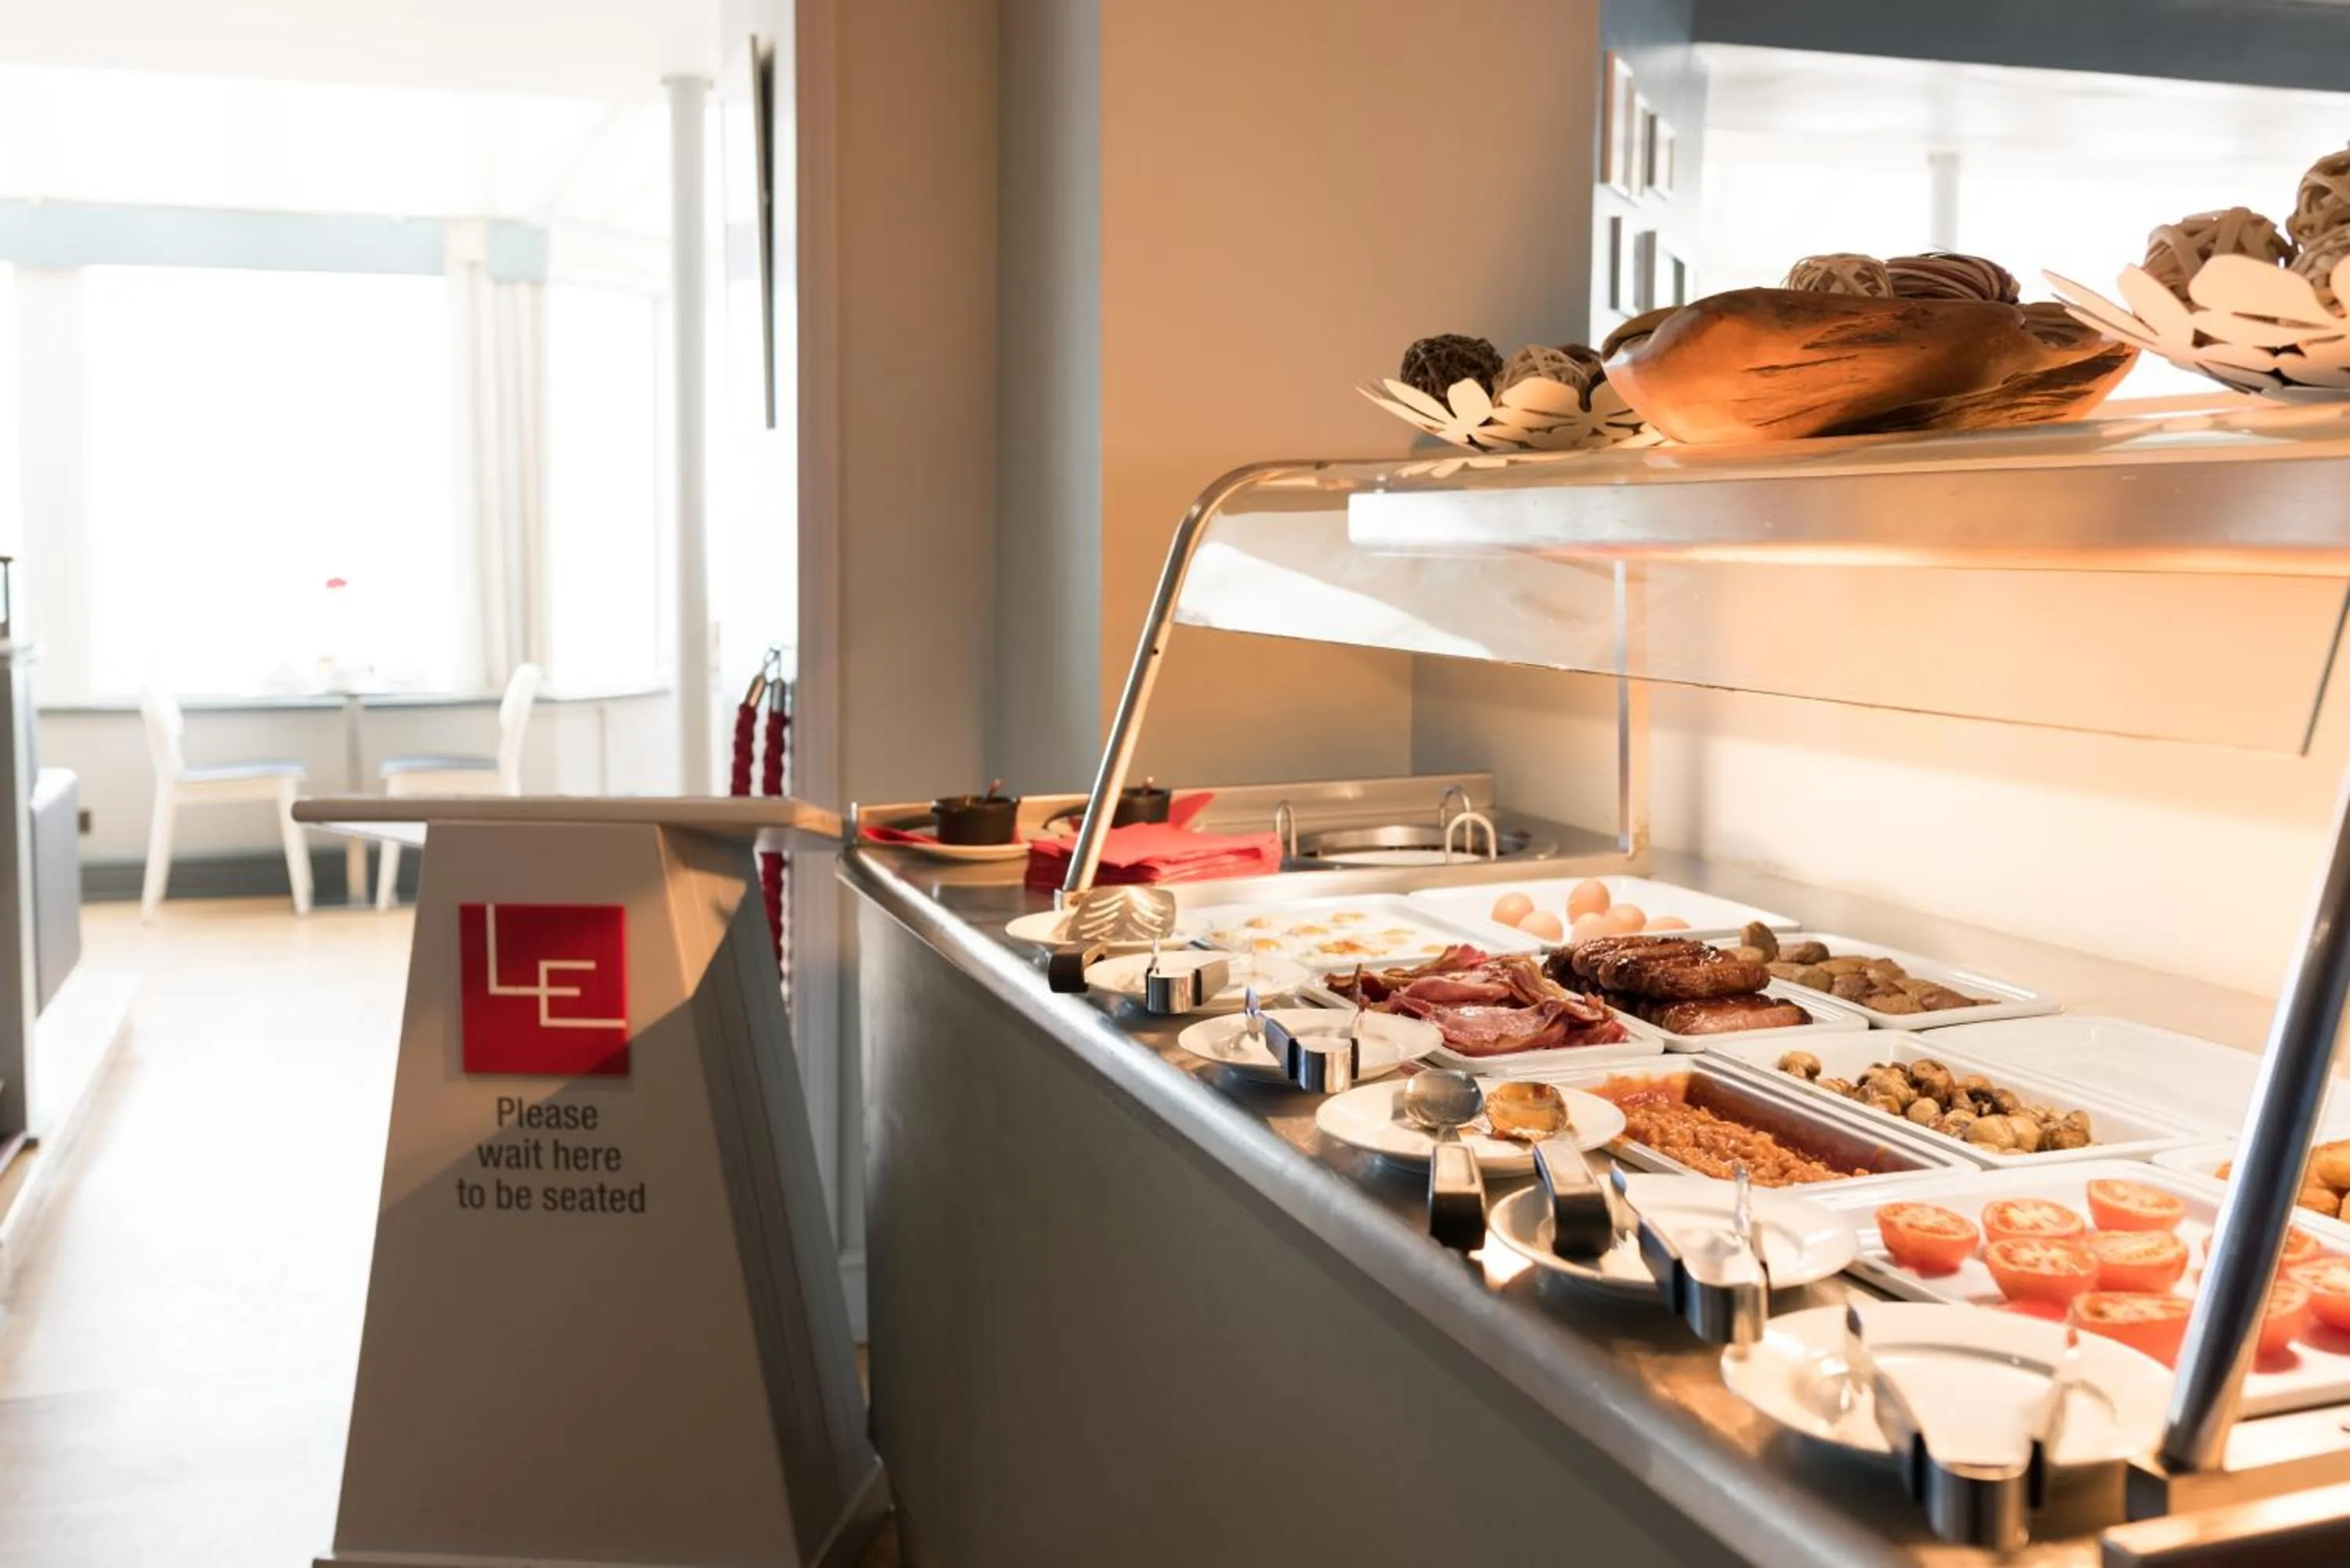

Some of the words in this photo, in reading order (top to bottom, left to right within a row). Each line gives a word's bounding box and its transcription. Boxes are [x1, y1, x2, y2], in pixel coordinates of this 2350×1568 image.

[496, 1097, 598, 1129] Please
[477, 1138, 543, 1169] wait
[553, 1139, 622, 1172] here
[457, 1178, 485, 1209] to
[497, 1179, 532, 1210] be
[542, 1182, 646, 1213] seated
